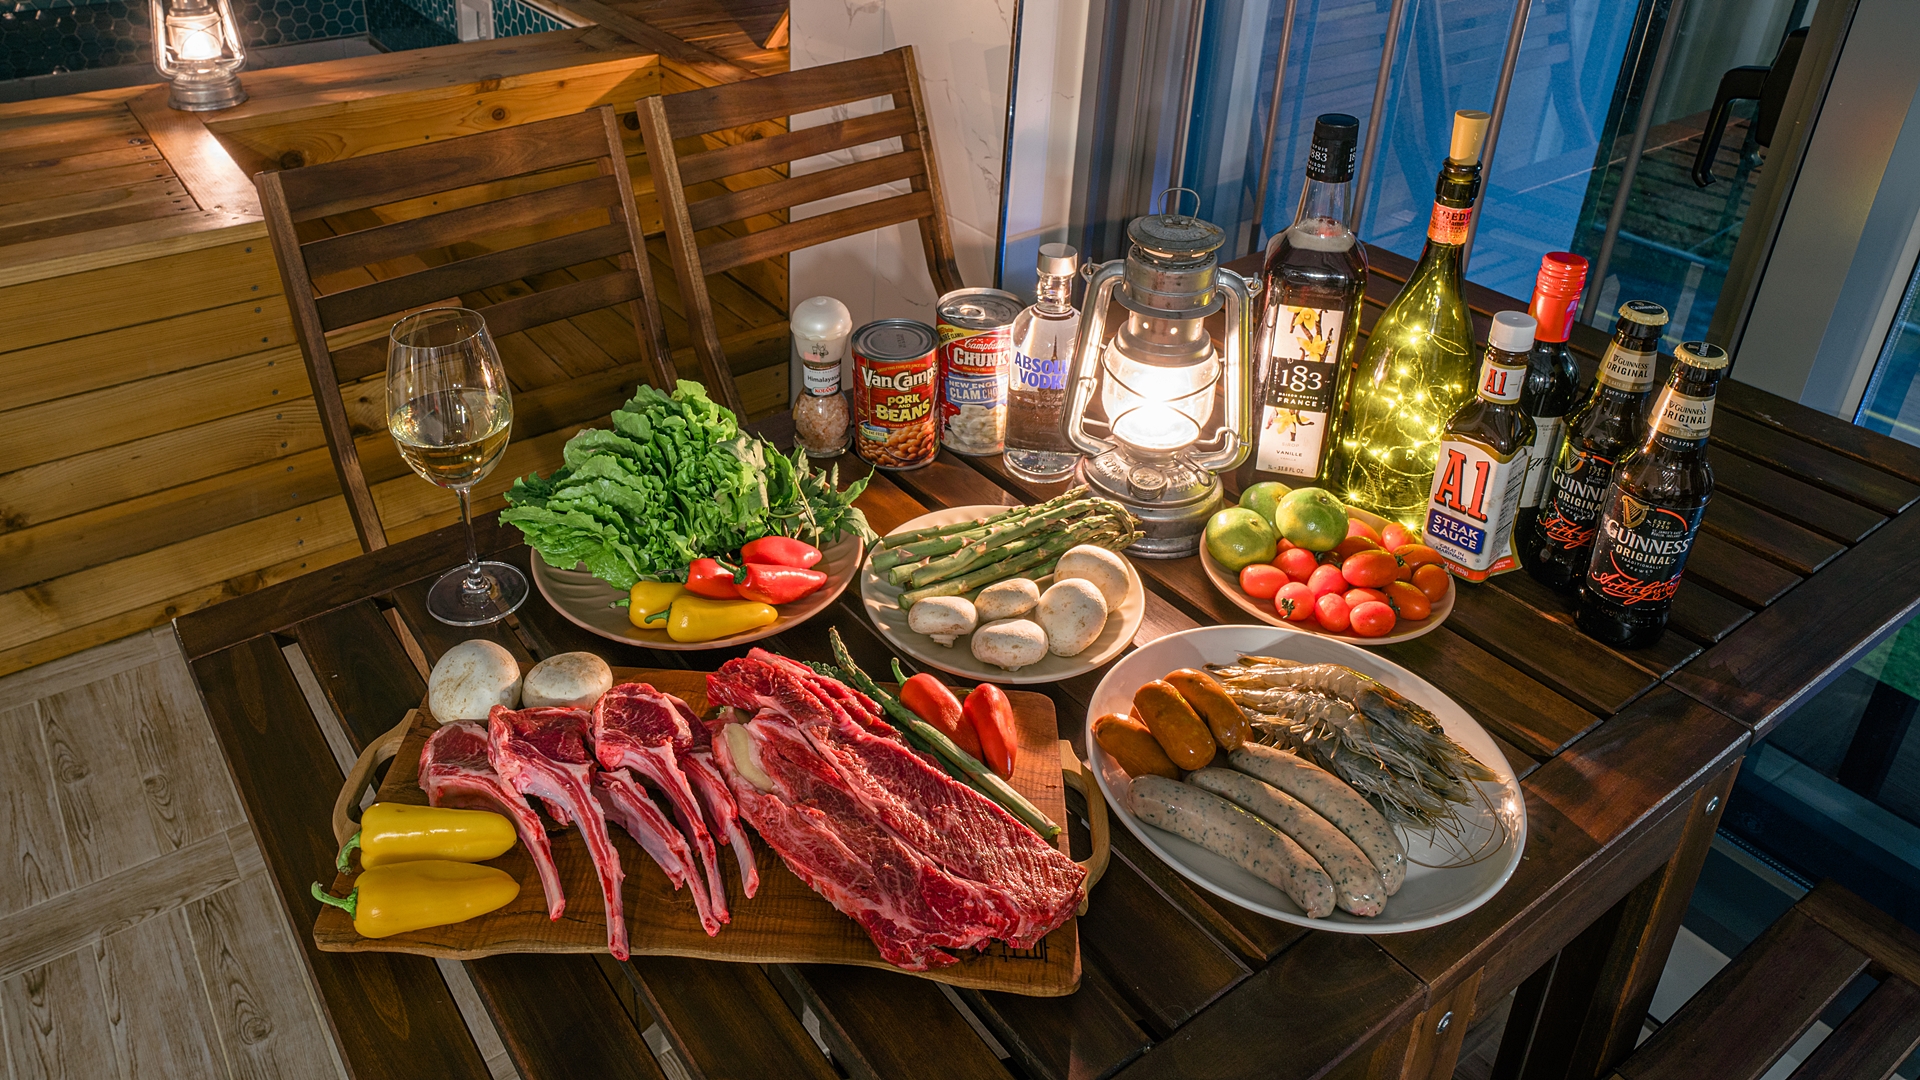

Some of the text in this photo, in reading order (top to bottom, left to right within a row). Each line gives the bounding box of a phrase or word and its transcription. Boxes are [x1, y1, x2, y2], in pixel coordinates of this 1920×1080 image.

[1310, 149, 1328, 162] 883
[1014, 351, 1067, 375] ABSOL
[1606, 362, 1648, 378] ORIGINAL
[1617, 357, 1650, 370] GUINNESS
[948, 380, 970, 389] NEW
[1019, 367, 1067, 390] VODK
[887, 393, 920, 406] PORK
[949, 387, 981, 400] CLAM
[1277, 397, 1318, 407] FRANCE
[876, 398, 930, 422] BEANS
[1552, 466, 1605, 501] GUINN
[1557, 489, 1603, 511] ORIGINA
[1431, 524, 1477, 550] SAUCE
[1433, 514, 1479, 541] STEAK
[1605, 519, 1689, 555] GUINNESS
[1615, 544, 1670, 565] ORIGINAL
[1621, 556, 1662, 570] TRADITIONALLY
